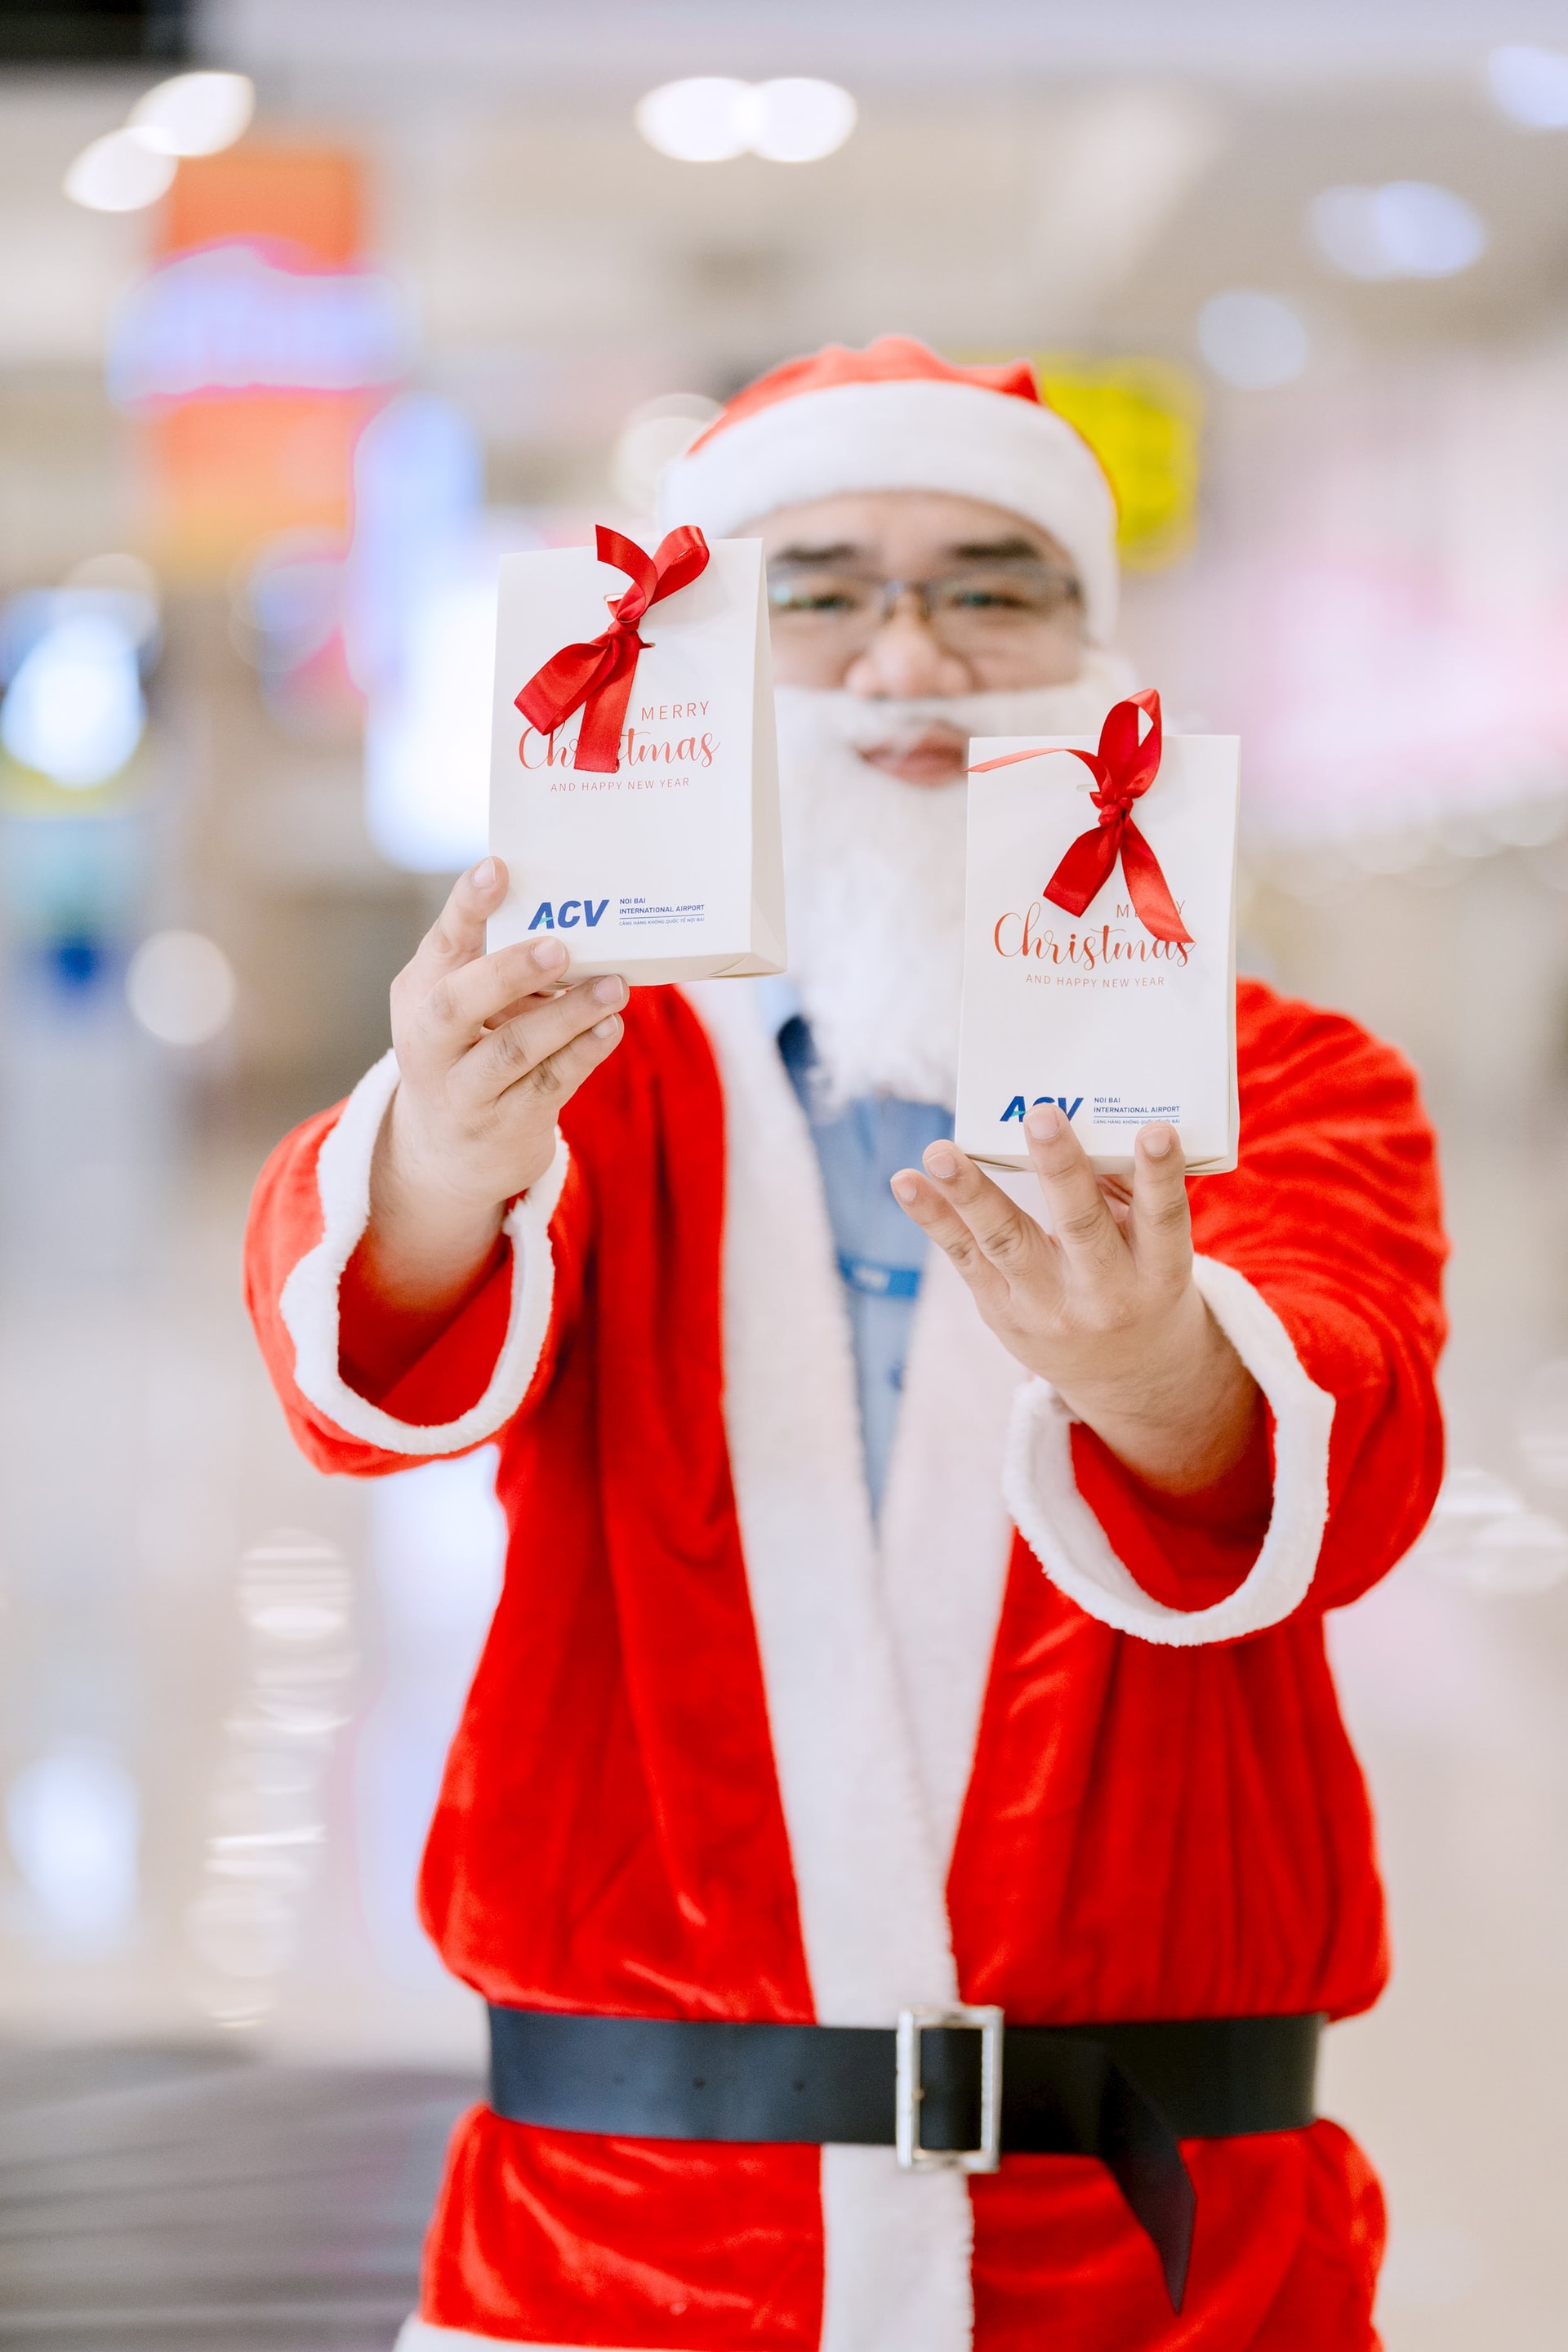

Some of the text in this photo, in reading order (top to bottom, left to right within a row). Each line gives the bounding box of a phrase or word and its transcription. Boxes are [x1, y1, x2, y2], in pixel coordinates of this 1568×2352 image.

[641, 701, 710, 721] MERRY
[519, 720, 720, 770] Chtmas
[550, 777, 689, 791] AND HAPPY NEW YEAR
[528, 899, 609, 930] ACV
[675, 904, 705, 912] AIRPORT
[994, 902, 1196, 970] Christmas
[1026, 974, 1165, 987] AND HAPPY NEW YEAR
[1000, 1096, 1084, 1122] AV
